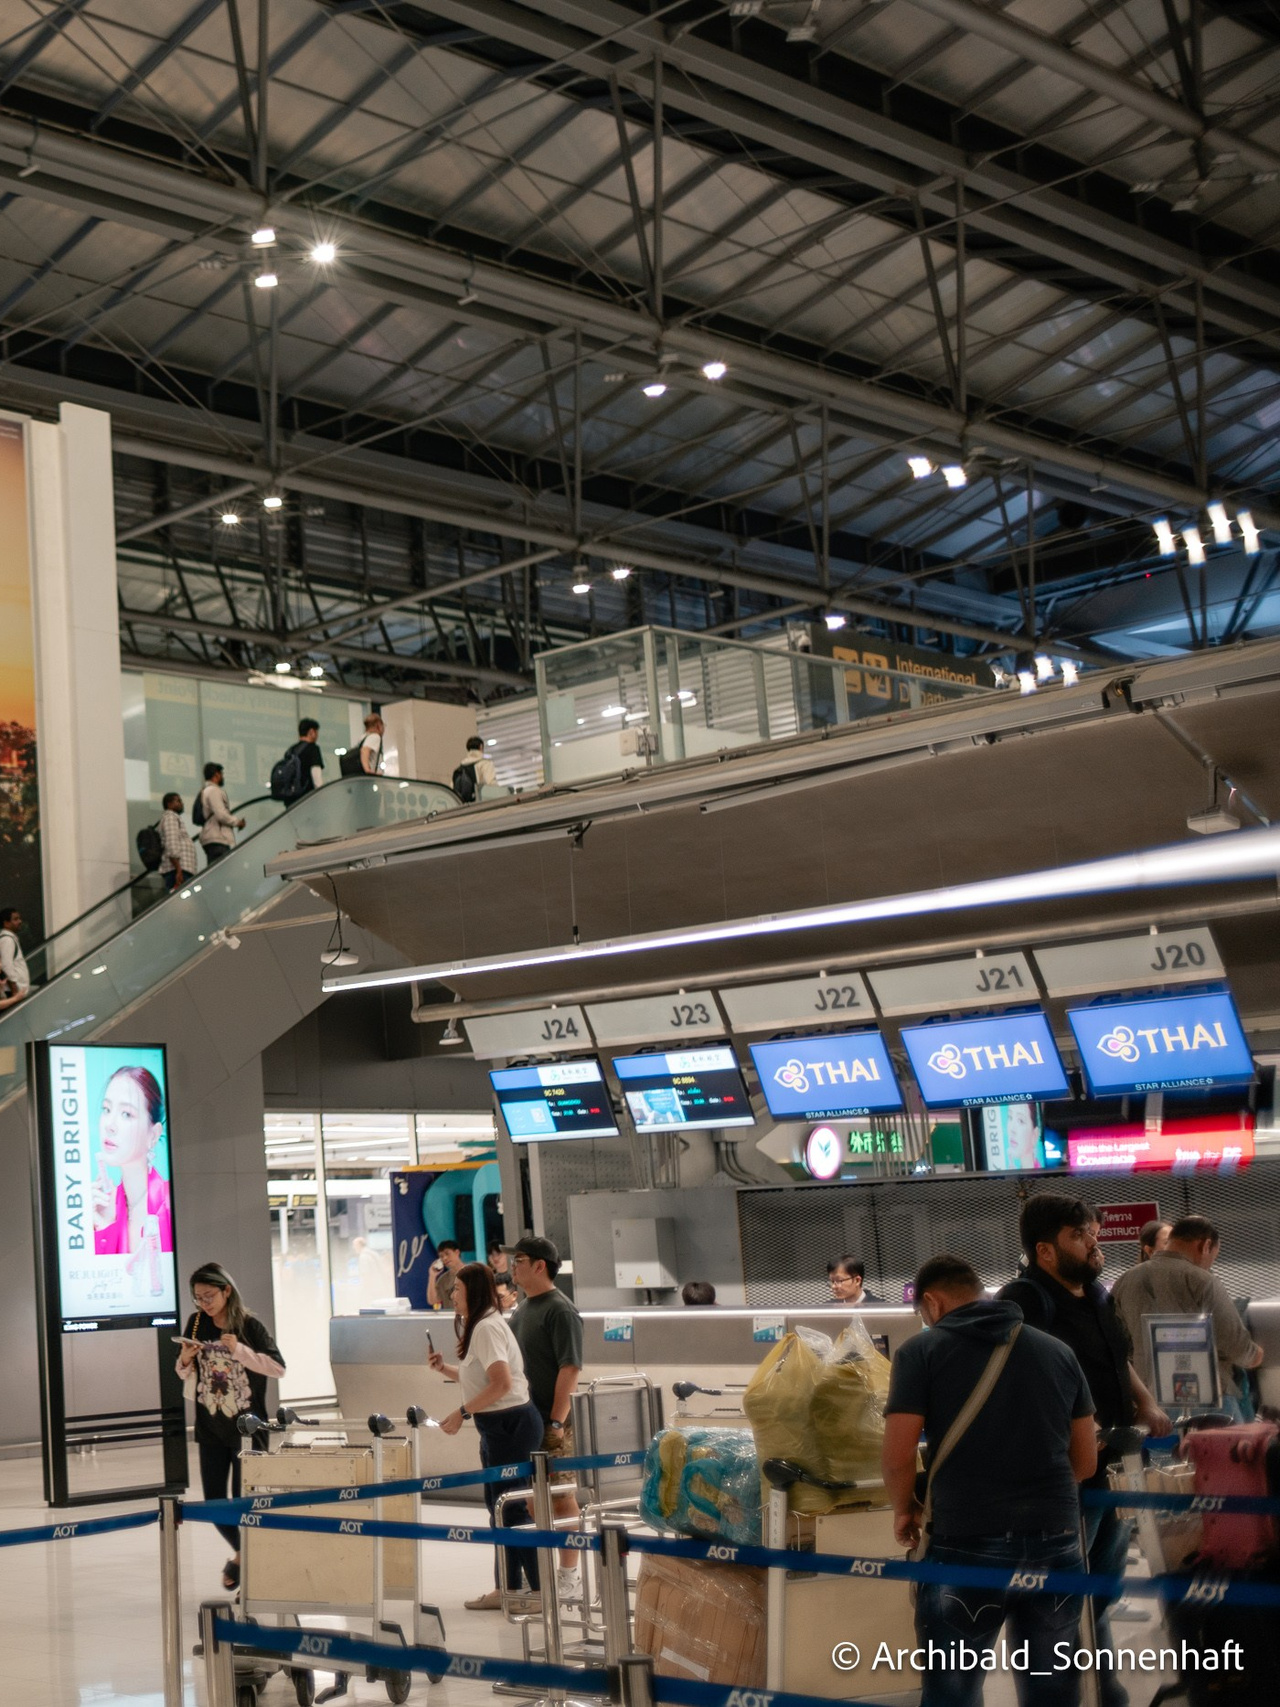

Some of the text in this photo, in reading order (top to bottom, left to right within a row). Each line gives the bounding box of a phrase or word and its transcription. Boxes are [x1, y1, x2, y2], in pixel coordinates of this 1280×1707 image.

[896, 654, 976, 685] International
[1150, 942, 1206, 971] J20
[976, 965, 1023, 992] J21
[814, 985, 860, 1012] J22
[670, 1003, 710, 1027] J23
[541, 1017, 578, 1041] J24
[1137, 1021, 1228, 1054] THAI
[963, 1041, 1045, 1071] THAI
[806, 1058, 881, 1085] THAI
[1135, 1079, 1206, 1091] STAR ALLIANCE
[963, 1093, 1025, 1106] STAR ALLIANCE
[805, 1108, 863, 1119] STAR ALLIANCE
[987, 1109, 1000, 1156] BRIG
[60, 1057, 85, 1250] BABY BRIGHT
[1099, 1143, 1113, 1152] the
[614, 1453, 632, 1465] AOT
[501, 1466, 518, 1478] AOT
[423, 1478, 442, 1490] AOT
[339, 1488, 360, 1500] AOT
[252, 1498, 273, 1510] AOT
[240, 1513, 262, 1526] AOT
[339, 1520, 363, 1534] AOT
[53, 1524, 78, 1538] AOT
[447, 1528, 473, 1541] AOT
[565, 1534, 594, 1548] AOT
[706, 1545, 739, 1561] AOT
[849, 1558, 885, 1577] AOT
[1009, 1572, 1048, 1590] AOT
[298, 1635, 333, 1654] AOT
[447, 1656, 485, 1676] AOT
